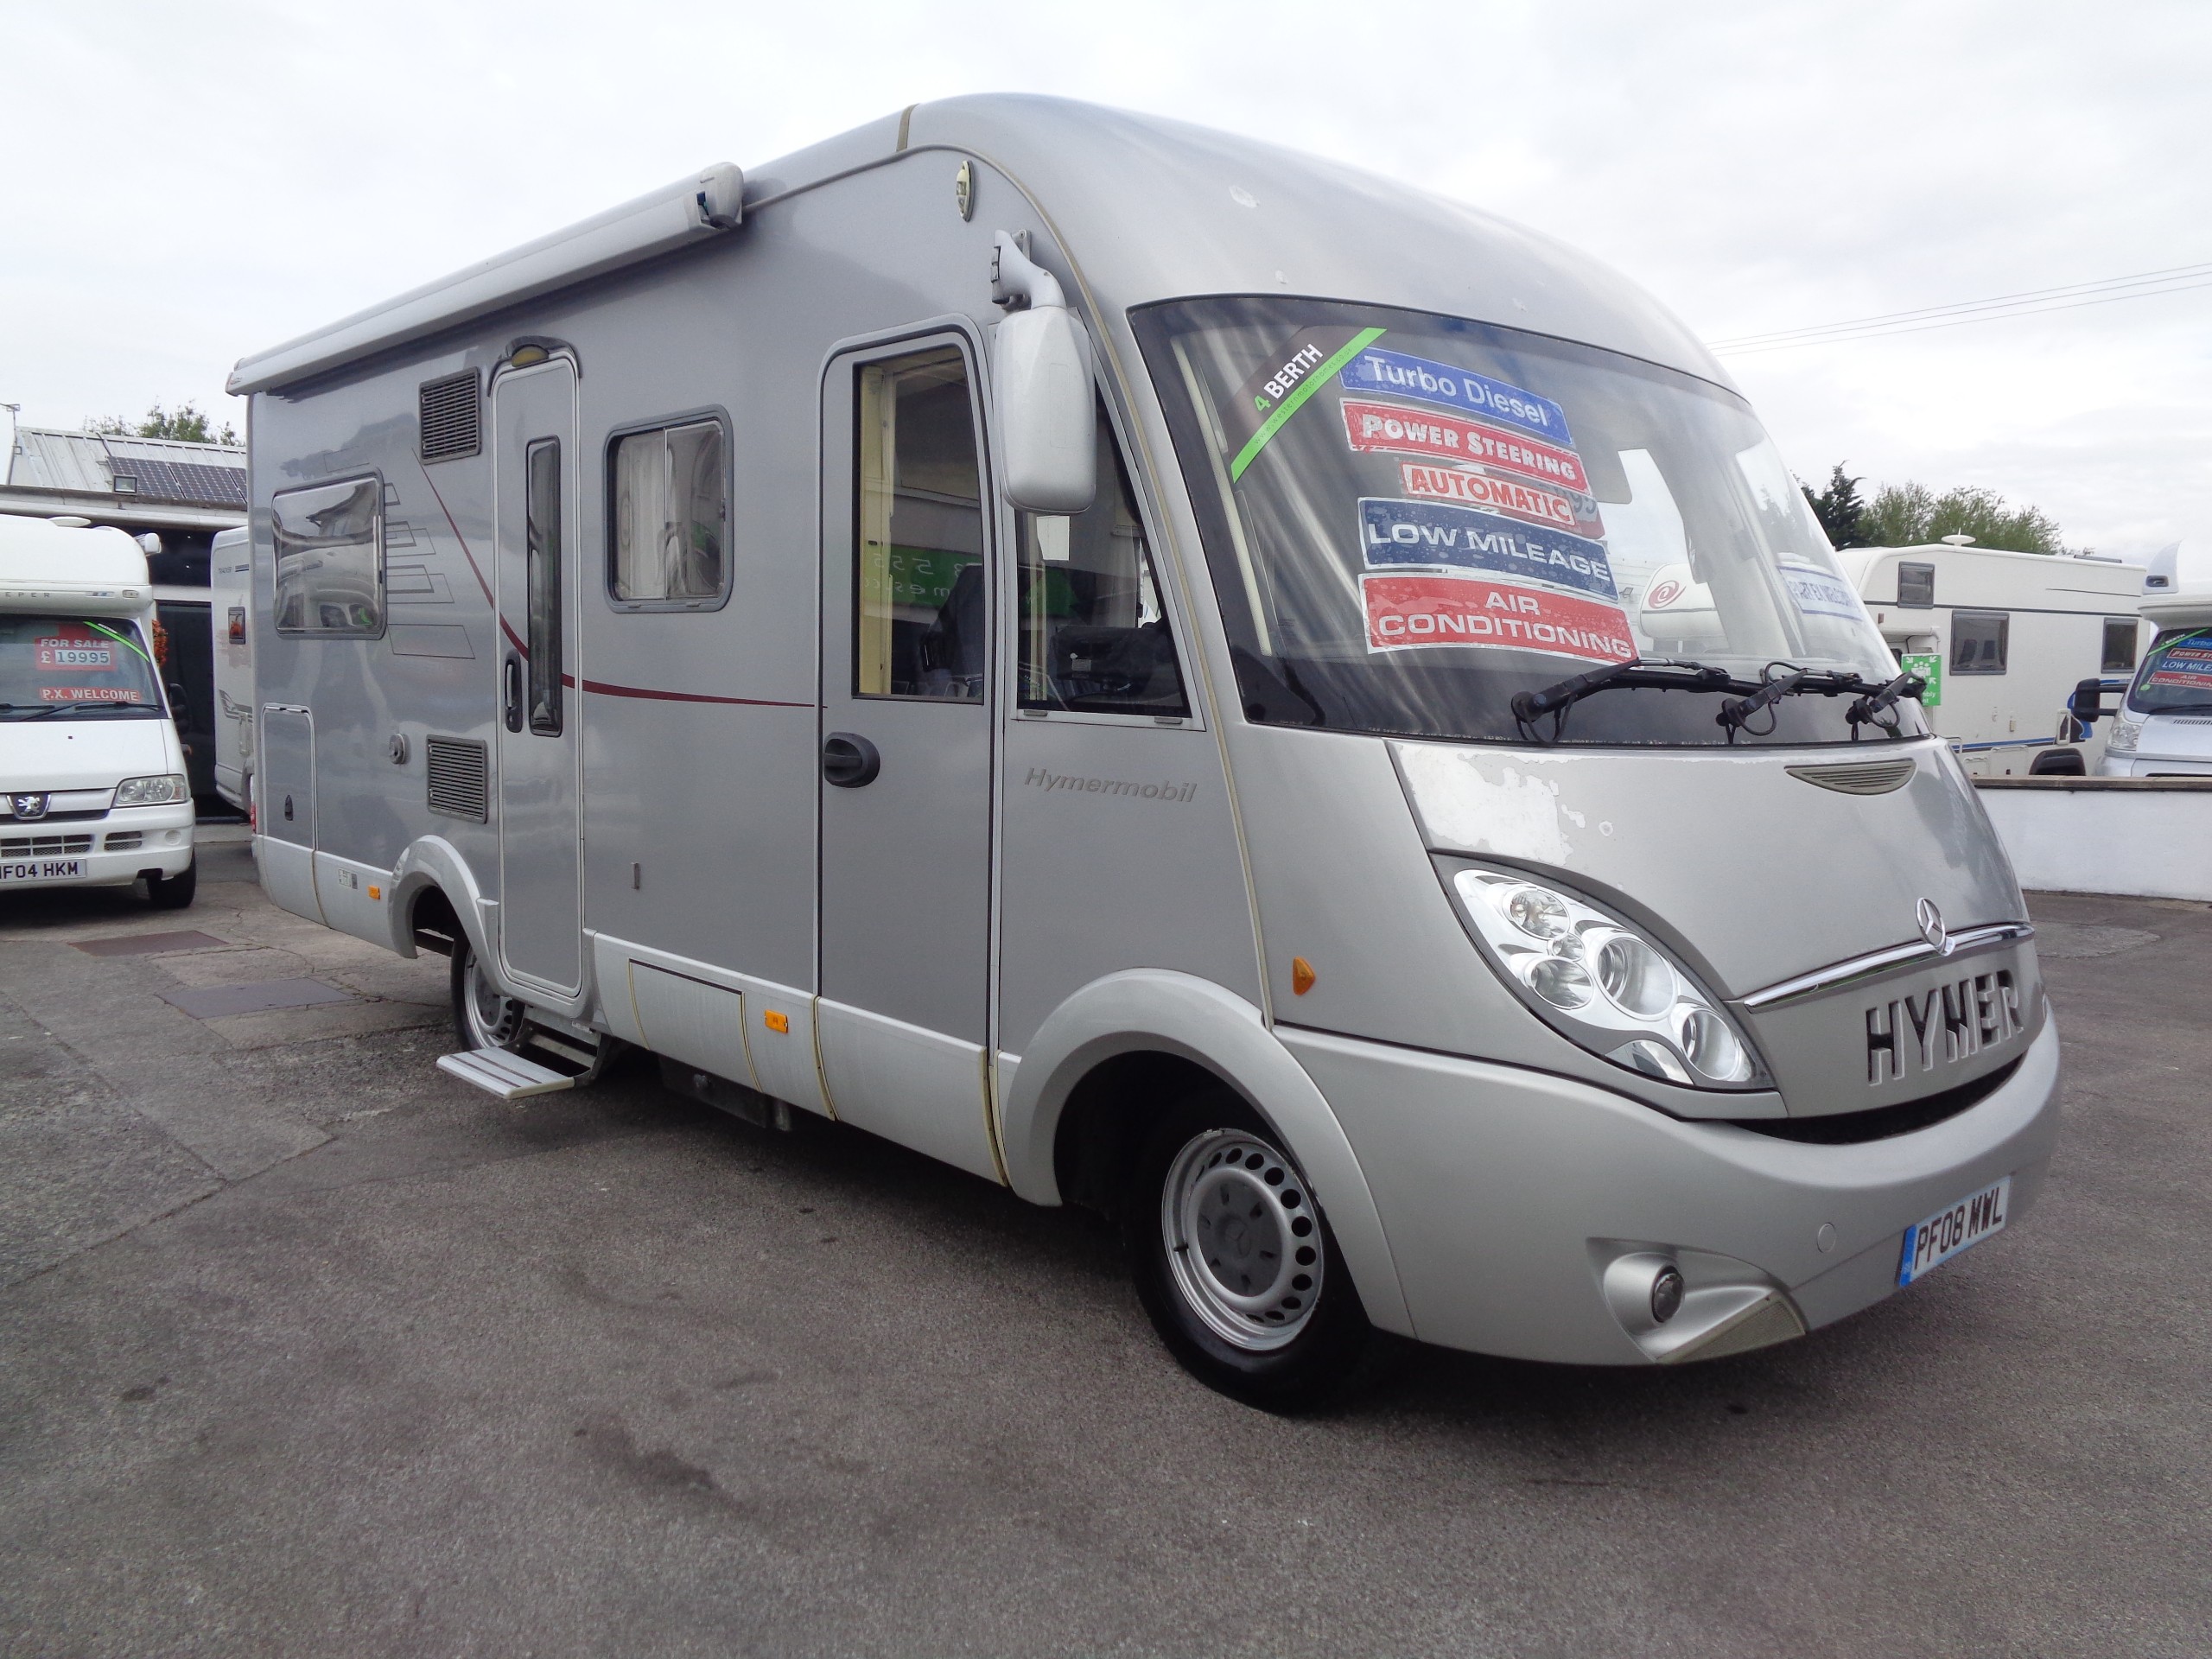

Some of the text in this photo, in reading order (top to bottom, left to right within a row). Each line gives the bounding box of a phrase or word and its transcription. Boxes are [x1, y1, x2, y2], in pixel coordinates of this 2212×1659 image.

[1254, 343, 1324, 411] 4 BERTH
[1363, 355, 1548, 427] Turbo Diesel
[1362, 413, 1577, 480] POWER STEERING
[1411, 468, 1571, 521] AUTOMATIC
[1368, 524, 1611, 581] LOW MILEAGE
[1484, 592, 1540, 616] AIR
[41, 639, 109, 648] FOR SALE
[41, 651, 110, 664] £ 19995
[1378, 613, 1632, 658] CONDITIONING
[71, 690, 139, 701] WELCOME
[1024, 767, 1198, 802] Hymermobil
[0, 862, 79, 880] F04 HKM
[1866, 969, 2024, 1087] HYMER
[1914, 1205, 1966, 1270] PF08
